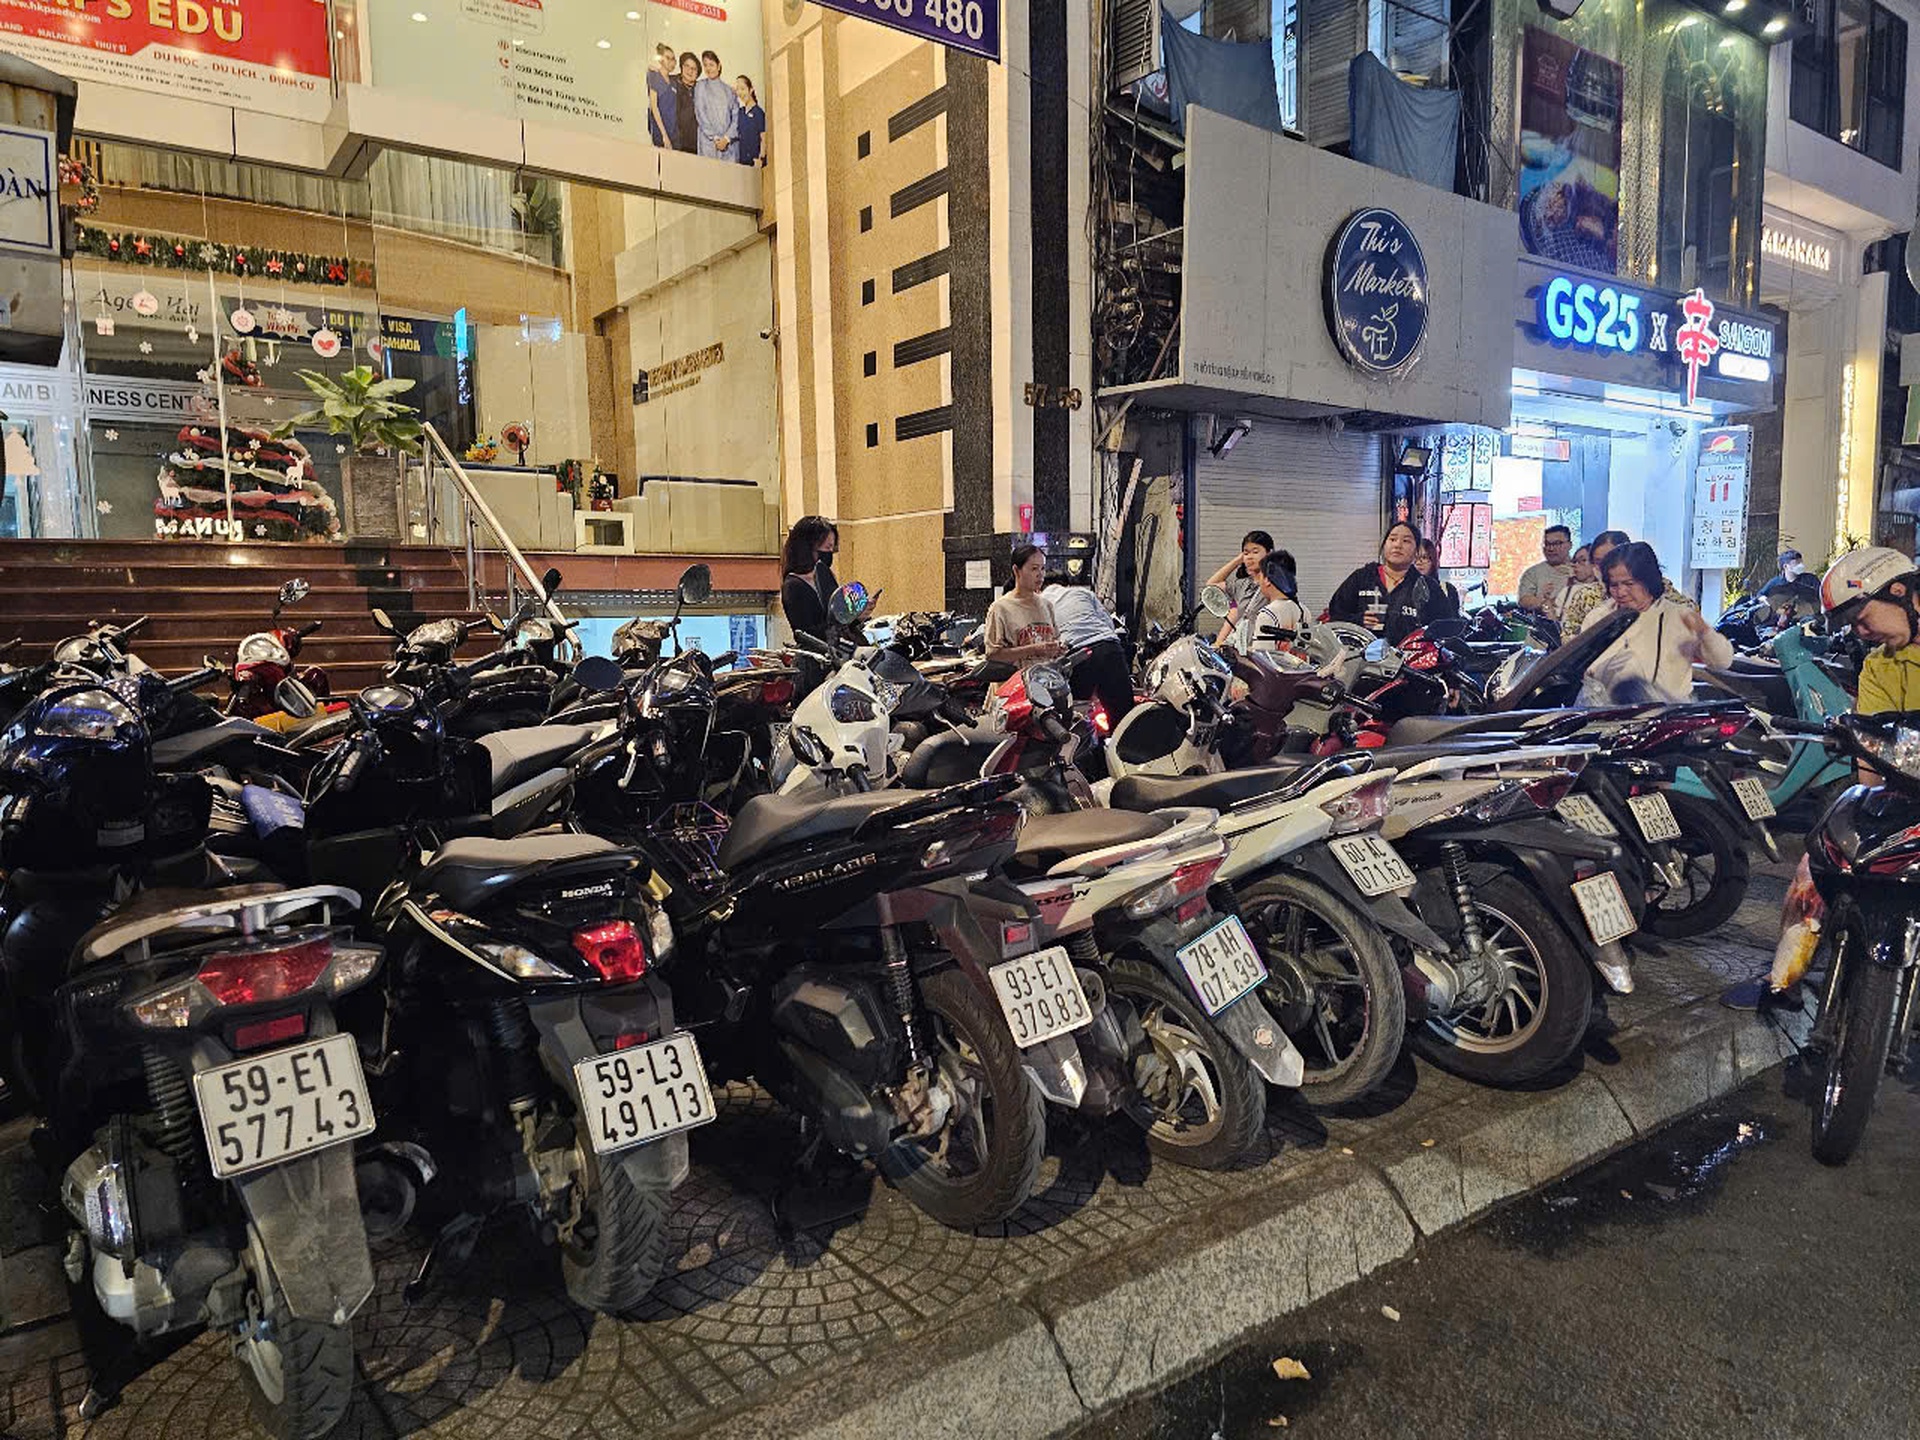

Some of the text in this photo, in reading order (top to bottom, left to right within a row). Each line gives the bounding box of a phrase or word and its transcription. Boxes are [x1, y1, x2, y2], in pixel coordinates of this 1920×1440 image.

[150, 0, 243, 42] EDU
[925, 0, 984, 40] 480
[153, 51, 170, 61] DU
[212, 62, 229, 73] DU
[231, 69, 257, 79] LỊCH
[329, 312, 345, 326] DU
[388, 320, 413, 334] VISA
[1546, 277, 1640, 352] GS25
[381, 337, 421, 352] CANADA
[1718, 319, 1772, 358] SAIGON
[1344, 837, 1387, 864] 60-AC
[562, 883, 612, 898] HONDA
[1354, 858, 1412, 890] 071.62
[1187, 926, 1241, 977] 78-AH
[1005, 957, 1065, 1000] 93-E1
[1011, 989, 1085, 1040] 379.83
[222, 1048, 335, 1114] 59-E1
[594, 1043, 684, 1100] 59-L3
[218, 1088, 363, 1167] 577.43
[601, 1080, 703, 1145] 491.13
